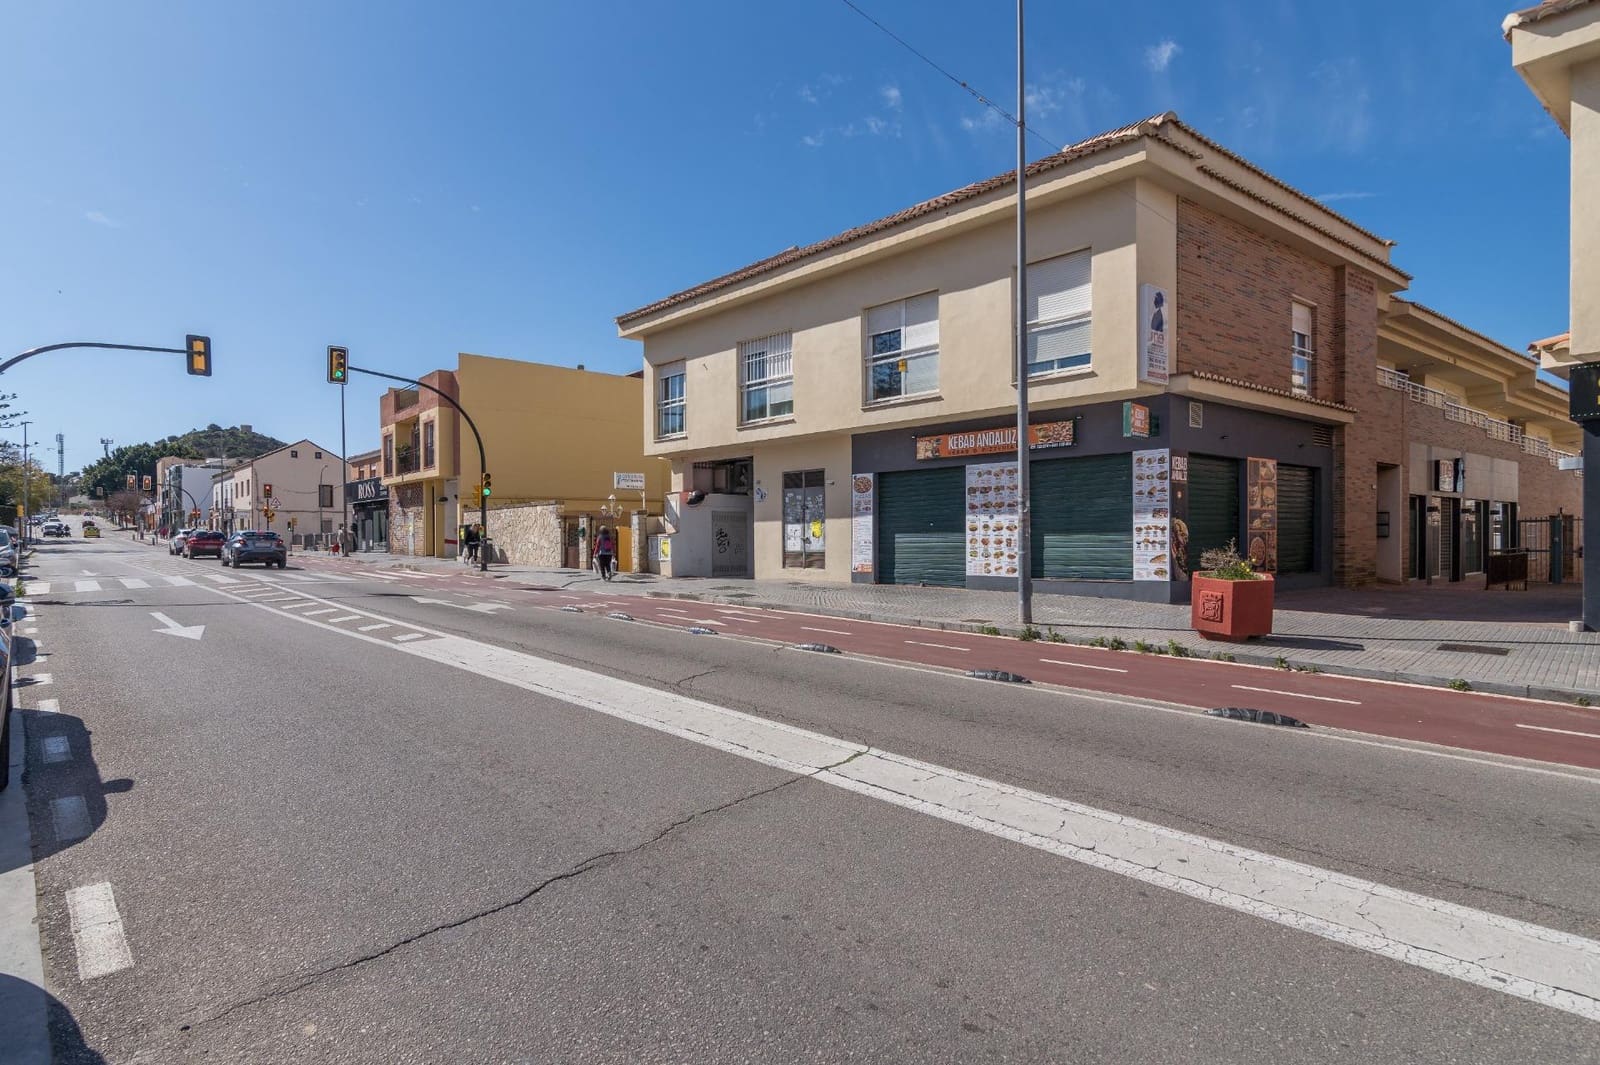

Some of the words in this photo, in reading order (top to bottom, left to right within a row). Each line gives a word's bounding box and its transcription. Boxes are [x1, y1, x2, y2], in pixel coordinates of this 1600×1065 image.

[948, 434, 975, 450] KEBAB
[976, 429, 1017, 447] ANDALUZ
[358, 481, 376, 499] ROSS
